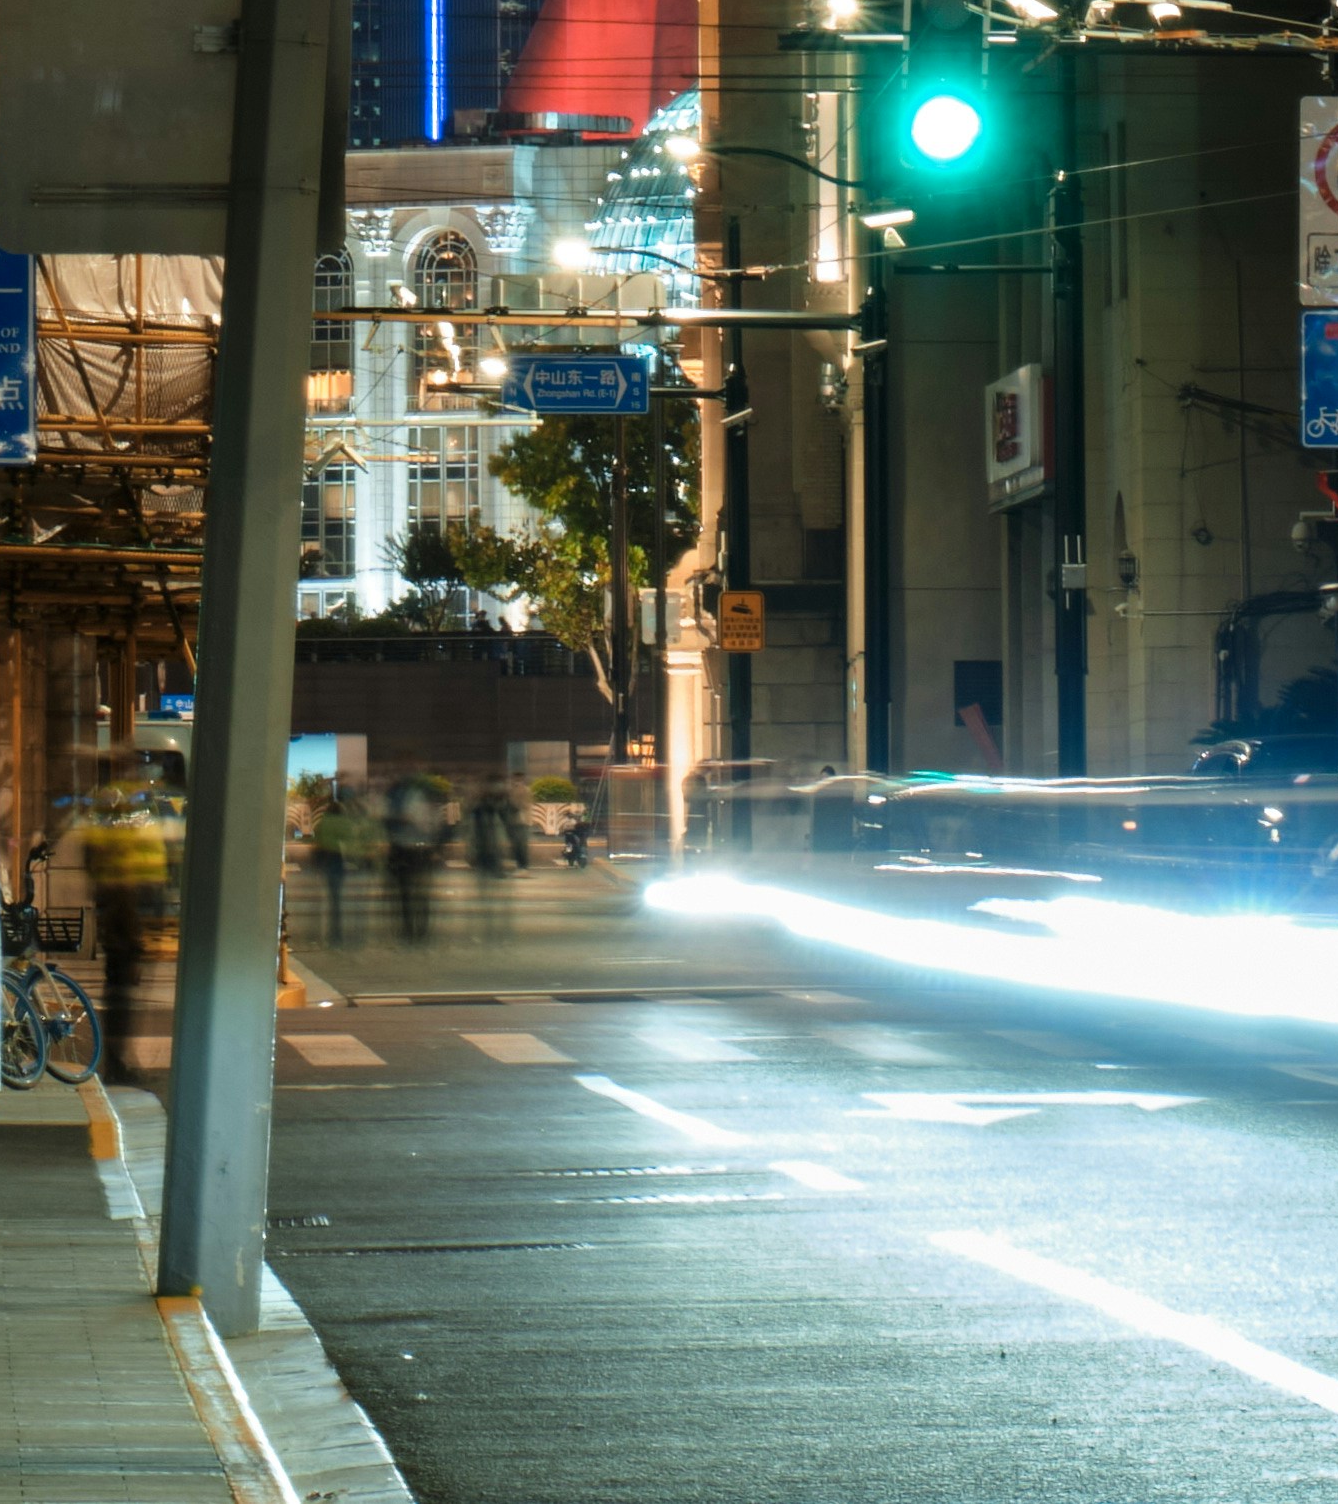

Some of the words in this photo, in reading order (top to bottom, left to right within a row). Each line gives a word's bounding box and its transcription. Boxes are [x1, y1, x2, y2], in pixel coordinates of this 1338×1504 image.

[0, 327, 20, 338] OF
[535, 369, 615, 386] 中山东一路
[536, 388, 581, 400] Zhongshan
